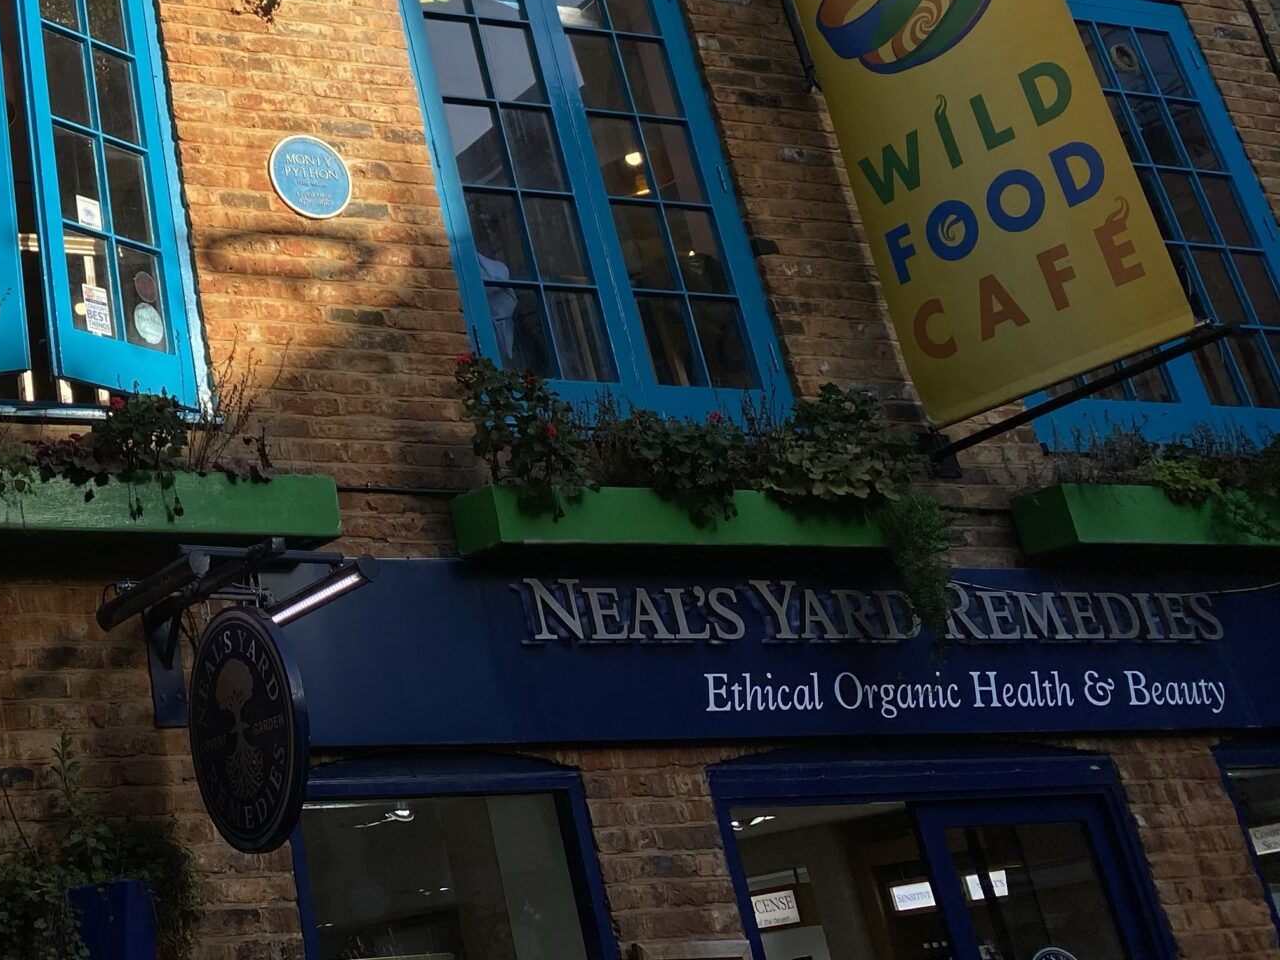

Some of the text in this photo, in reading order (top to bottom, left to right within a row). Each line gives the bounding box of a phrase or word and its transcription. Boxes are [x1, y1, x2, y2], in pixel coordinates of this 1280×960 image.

[858, 62, 1072, 205] WILD
[284, 165, 338, 181] PYTHON
[285, 153, 332, 167] MONTY
[885, 141, 1105, 285] FOOD
[87, 310, 108, 322] BEST
[523, 577, 1224, 640] NEAL'S YARD REMEDIES
[197, 628, 279, 726] NEAL'S YARD
[704, 670, 1225, 718] Ethical Organic Health & Beauty
[253, 711, 285, 736] GARDEN
